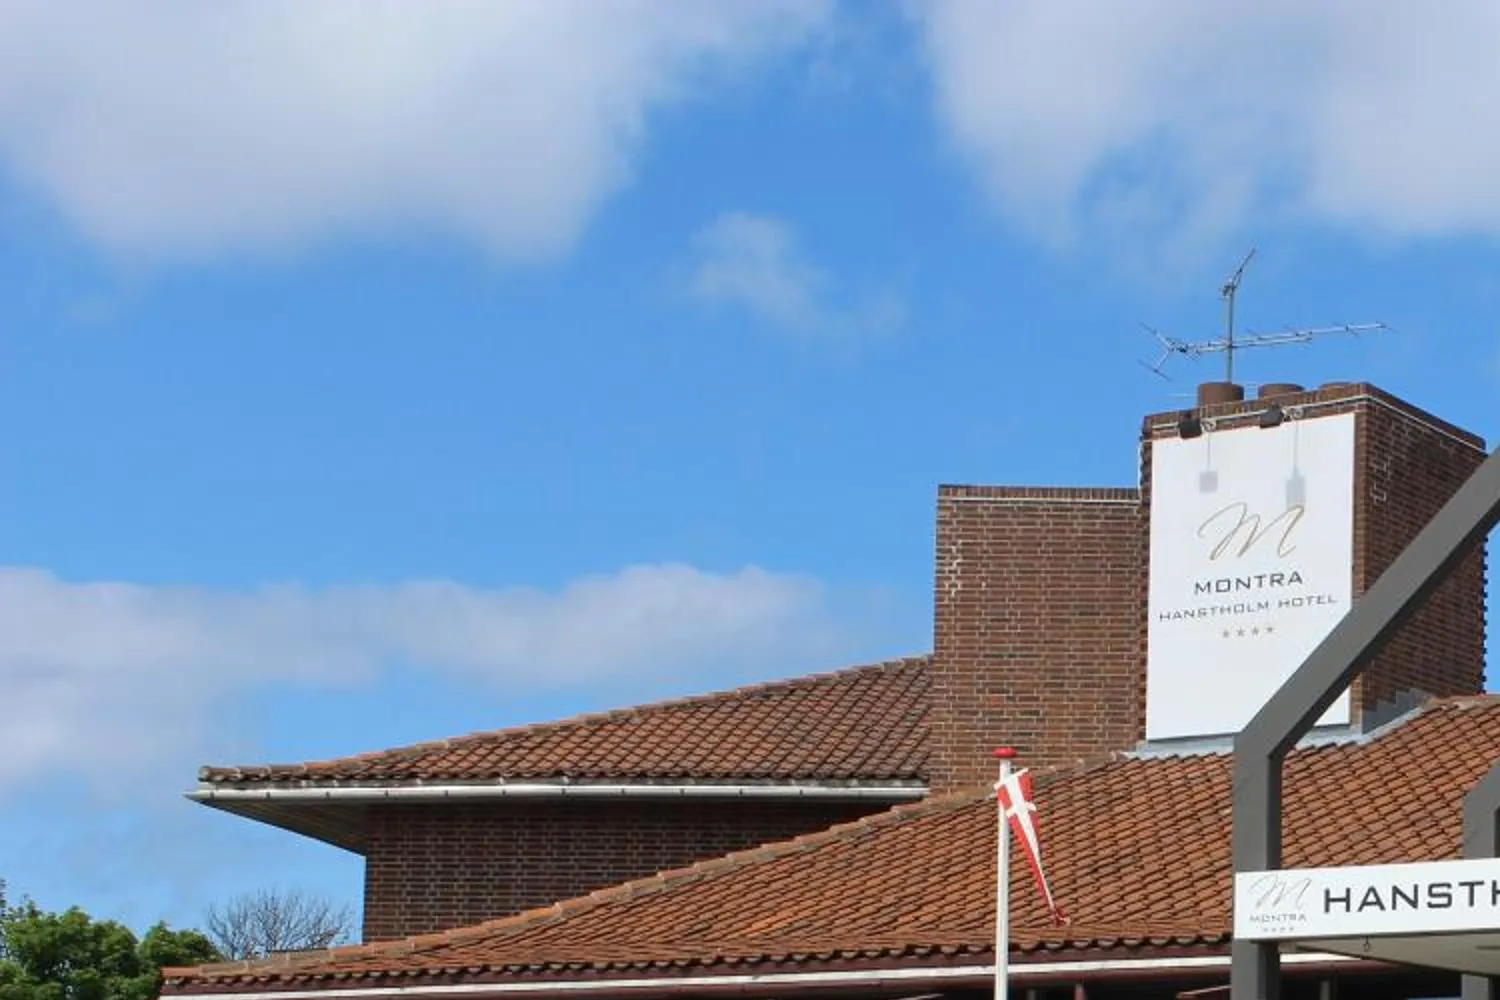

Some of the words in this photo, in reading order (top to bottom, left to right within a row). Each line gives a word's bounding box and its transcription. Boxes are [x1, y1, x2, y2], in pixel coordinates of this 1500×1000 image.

[1193, 570, 1304, 595] MONTRA
[1159, 600, 1270, 622] HANSTHOLM
[1277, 594, 1338, 609] HOTEL
[1249, 912, 1307, 923] MONTRA
